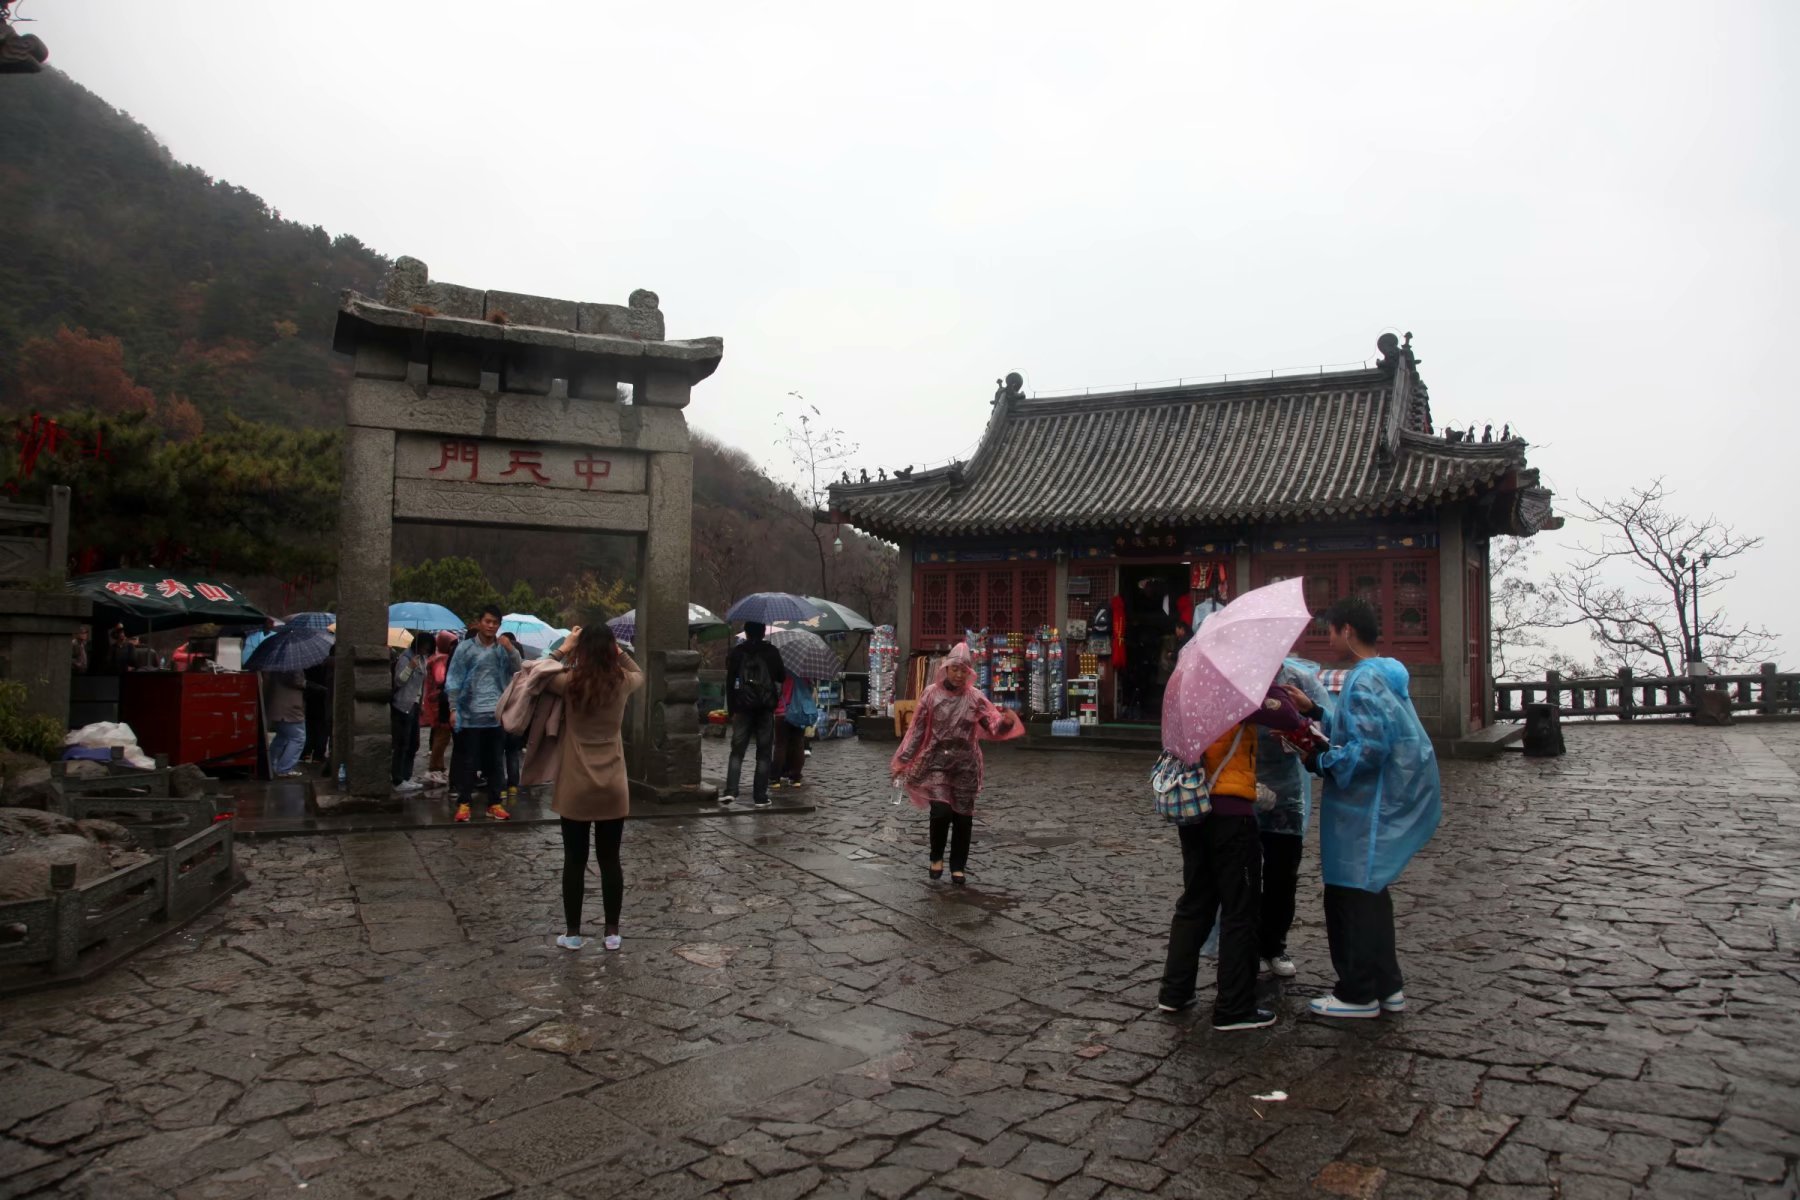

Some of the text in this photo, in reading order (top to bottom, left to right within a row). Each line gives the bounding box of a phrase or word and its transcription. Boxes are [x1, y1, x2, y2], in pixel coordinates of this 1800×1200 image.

[428, 441, 612, 490] 中天門
[105, 578, 241, 602] 农夫山
